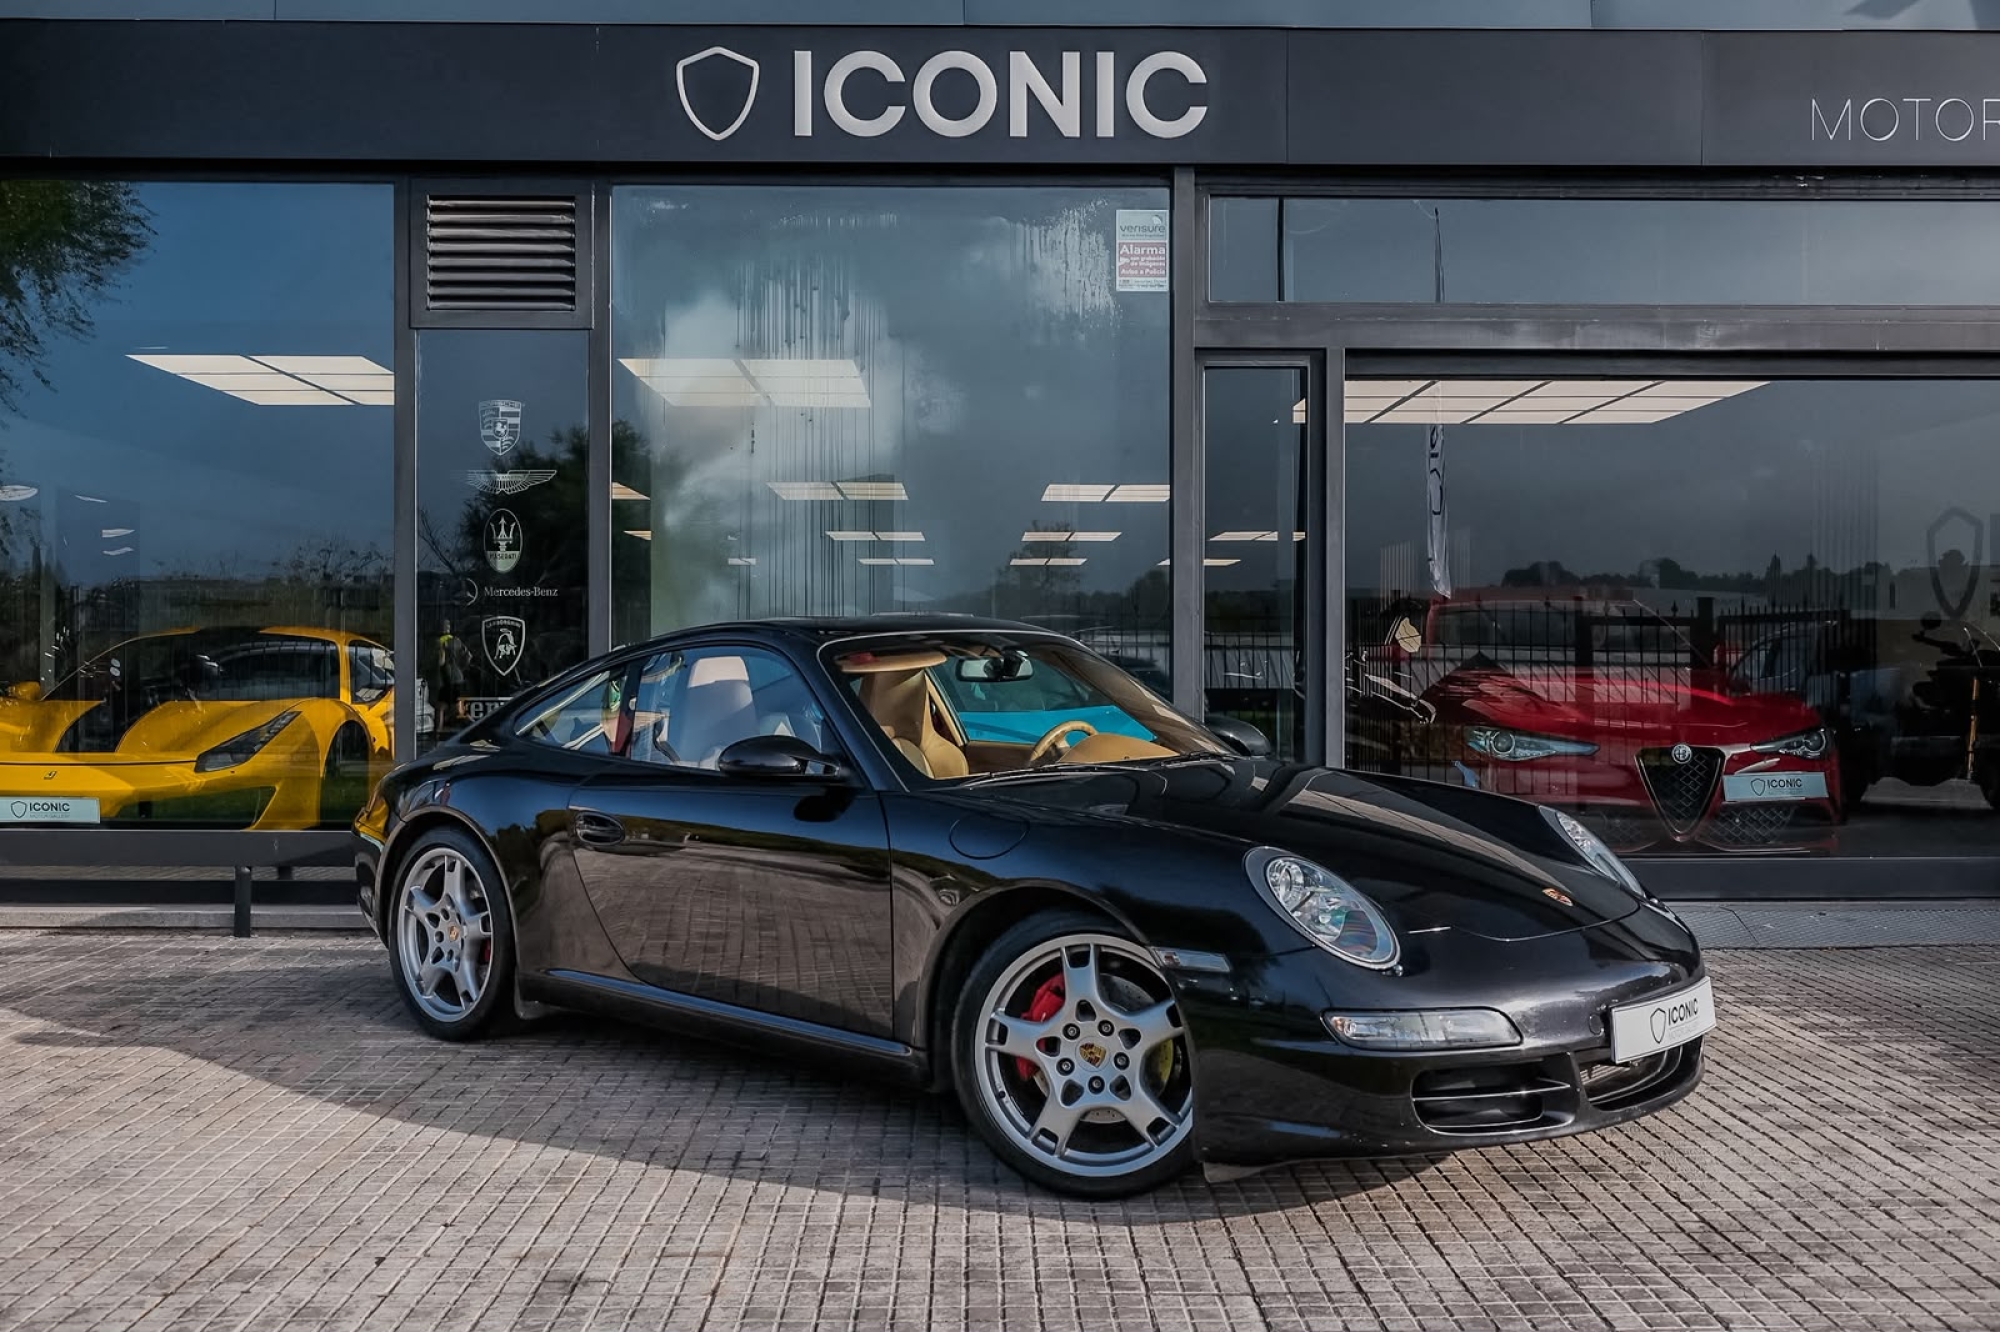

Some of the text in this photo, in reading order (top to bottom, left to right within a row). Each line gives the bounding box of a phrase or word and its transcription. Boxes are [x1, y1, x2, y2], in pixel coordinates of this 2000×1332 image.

[794, 50, 1208, 138] ICONIC
[1119, 244, 1166, 255] Alarma
[484, 586, 559, 597] Mercedes-Benz
[1767, 778, 1802, 789] ICONIC
[29, 802, 71, 812] ICONIC
[1668, 998, 1699, 1027] ICONIC
